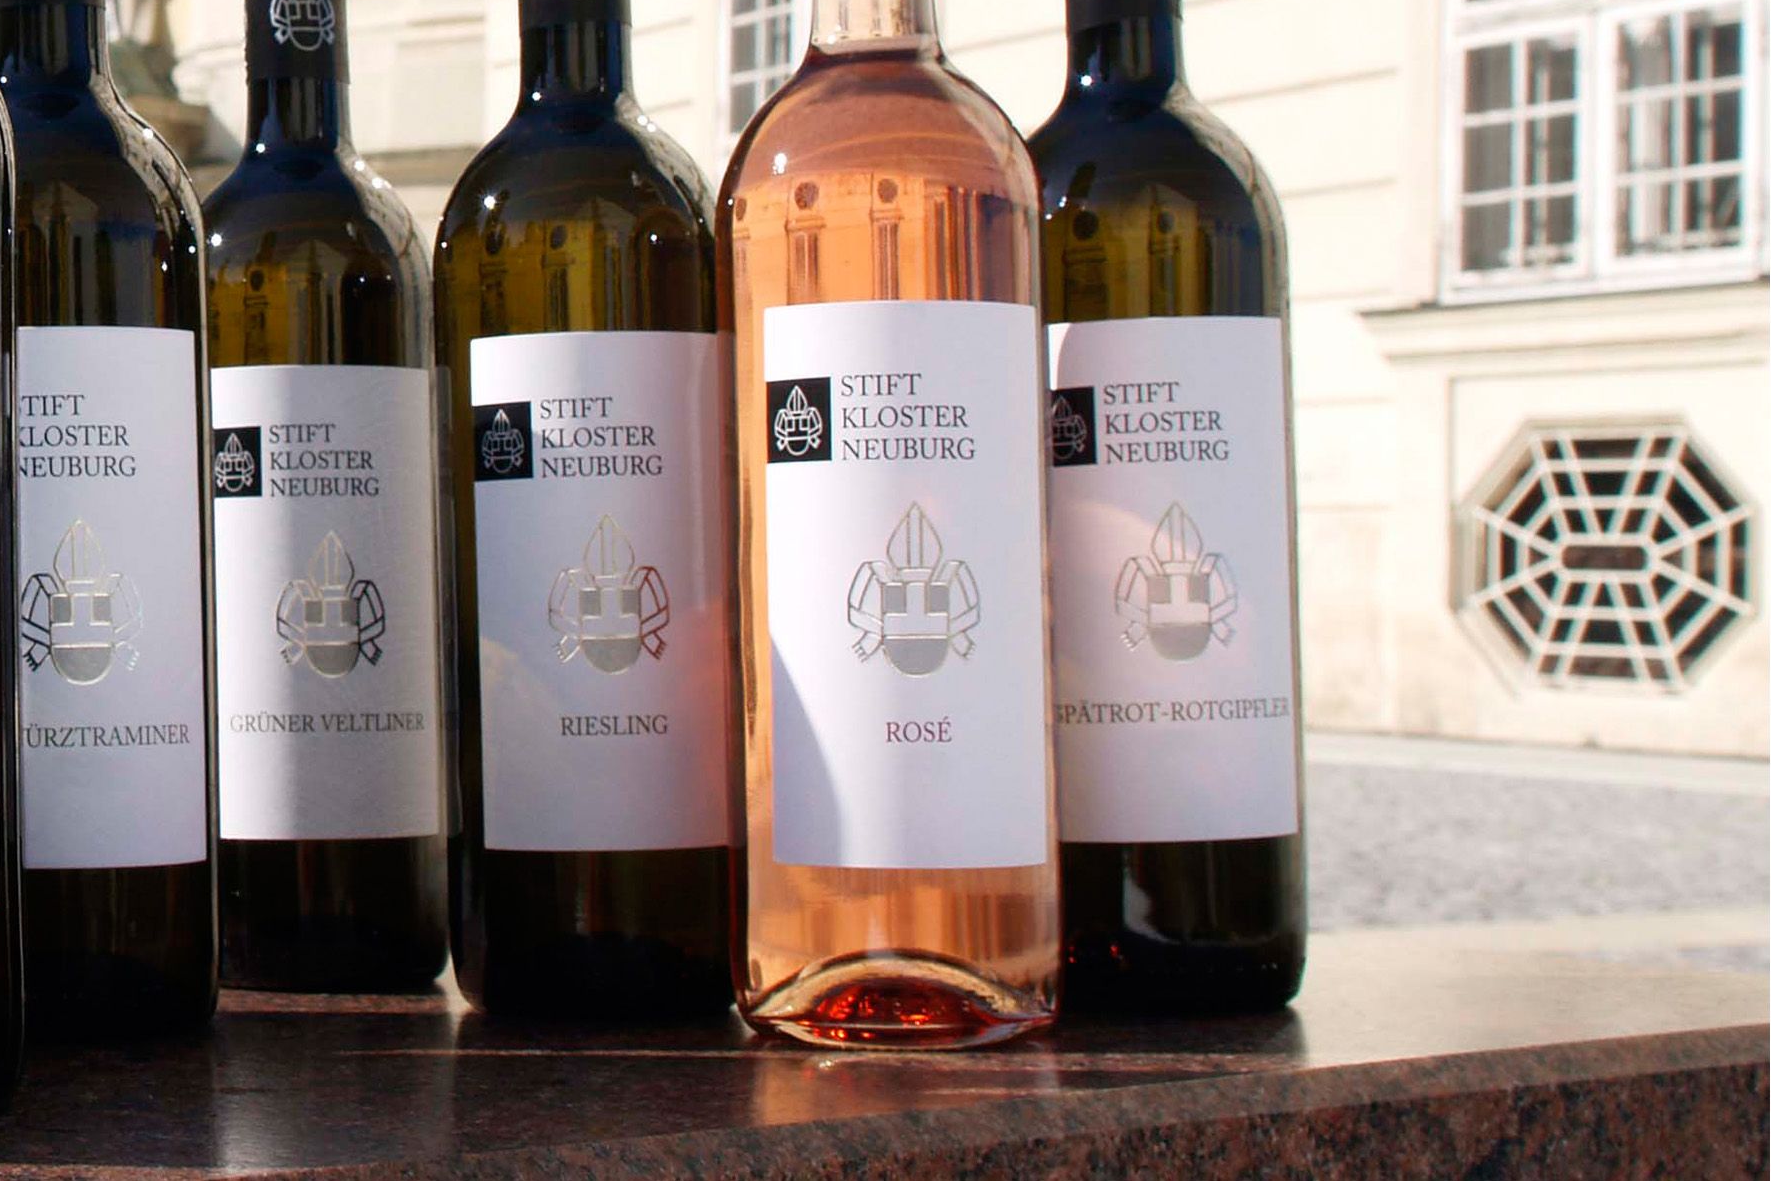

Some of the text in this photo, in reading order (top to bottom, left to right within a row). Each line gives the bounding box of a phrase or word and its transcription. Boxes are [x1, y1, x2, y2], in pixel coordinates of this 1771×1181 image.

[841, 373, 921, 396] STIFT
[1103, 382, 1179, 405] STIFT
[20, 395, 84, 417] TIFT
[540, 397, 612, 419] STIFT
[842, 405, 968, 428] KLOSTER
[269, 424, 335, 444] STIFT
[1105, 411, 1222, 434] KLOSTER
[541, 426, 656, 449] KLOSTER
[842, 437, 975, 460] NEUBURG
[270, 450, 373, 471] KLOSTER
[1105, 440, 1229, 464] NEUBURG
[541, 455, 662, 478] NEUBURG
[270, 477, 379, 499] NEUBURG
[230, 710, 425, 733] GRÜNER VELTLINER
[1056, 697, 1289, 725] SPÄTROT-ROTGIPFLER
[22, 723, 190, 749] ÜRZTRAMINER
[561, 715, 668, 736] RIESLING
[885, 715, 954, 744] ROSÉ
